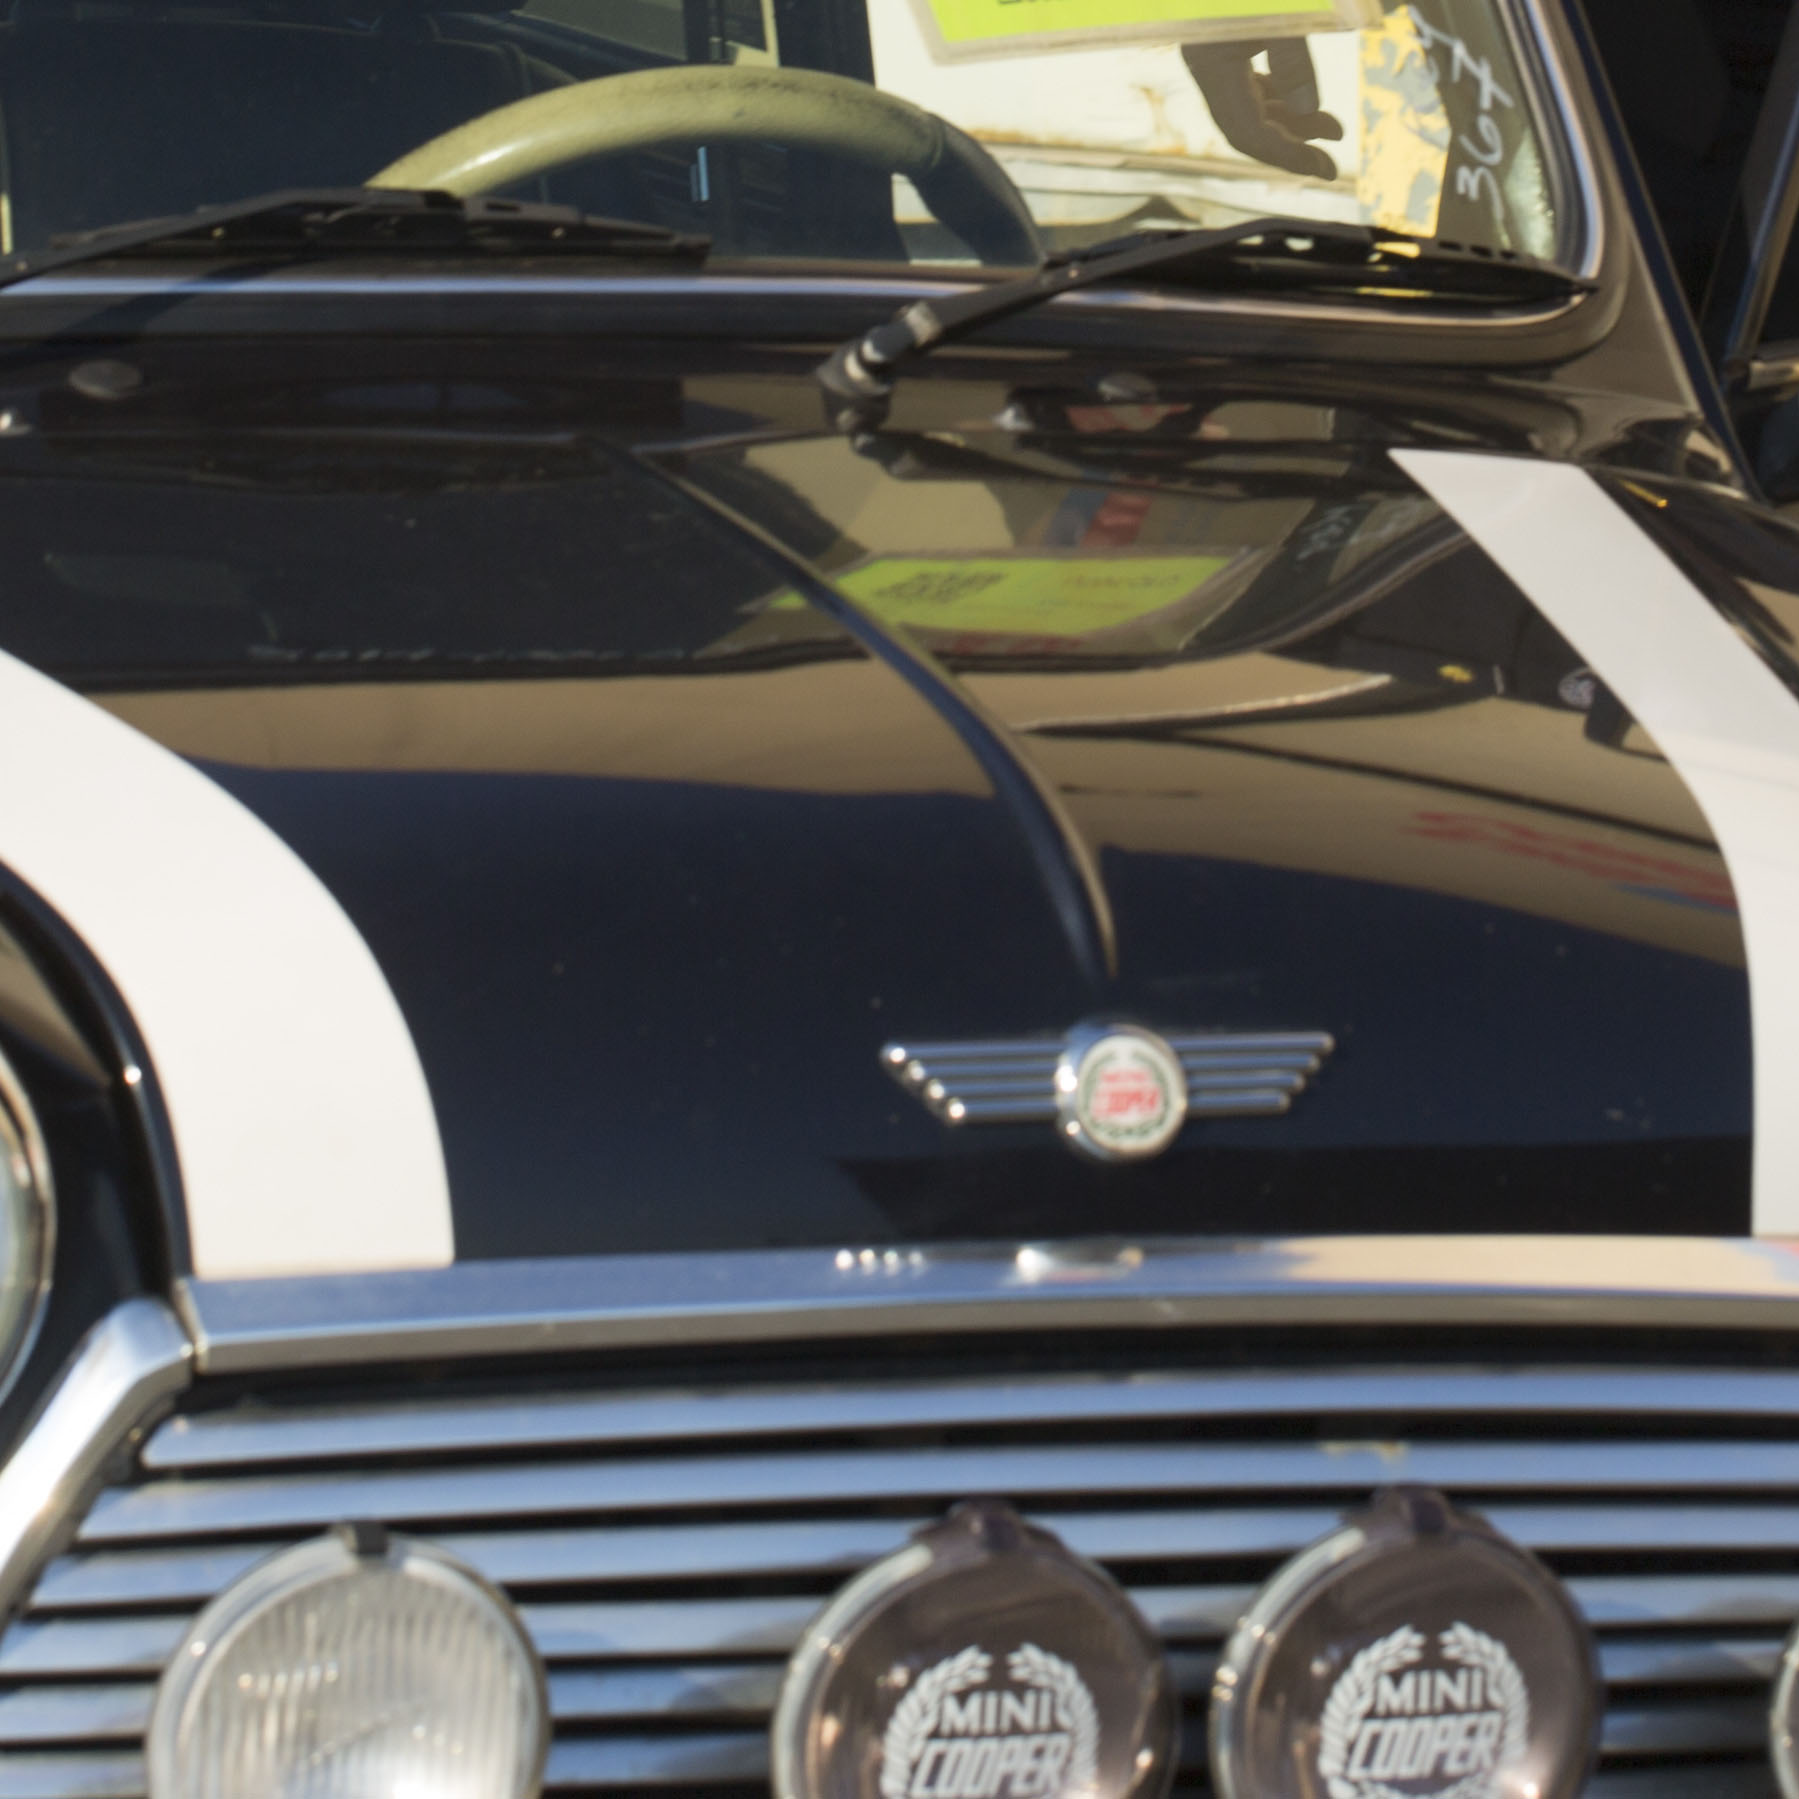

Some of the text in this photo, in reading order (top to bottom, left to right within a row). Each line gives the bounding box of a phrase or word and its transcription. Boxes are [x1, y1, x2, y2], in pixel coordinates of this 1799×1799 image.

[940, 1689, 1054, 1737] MINI
[1375, 1668, 1484, 1716] MINI
[910, 1731, 1072, 1798] COOPER
[1346, 1710, 1503, 1781] COOPER
